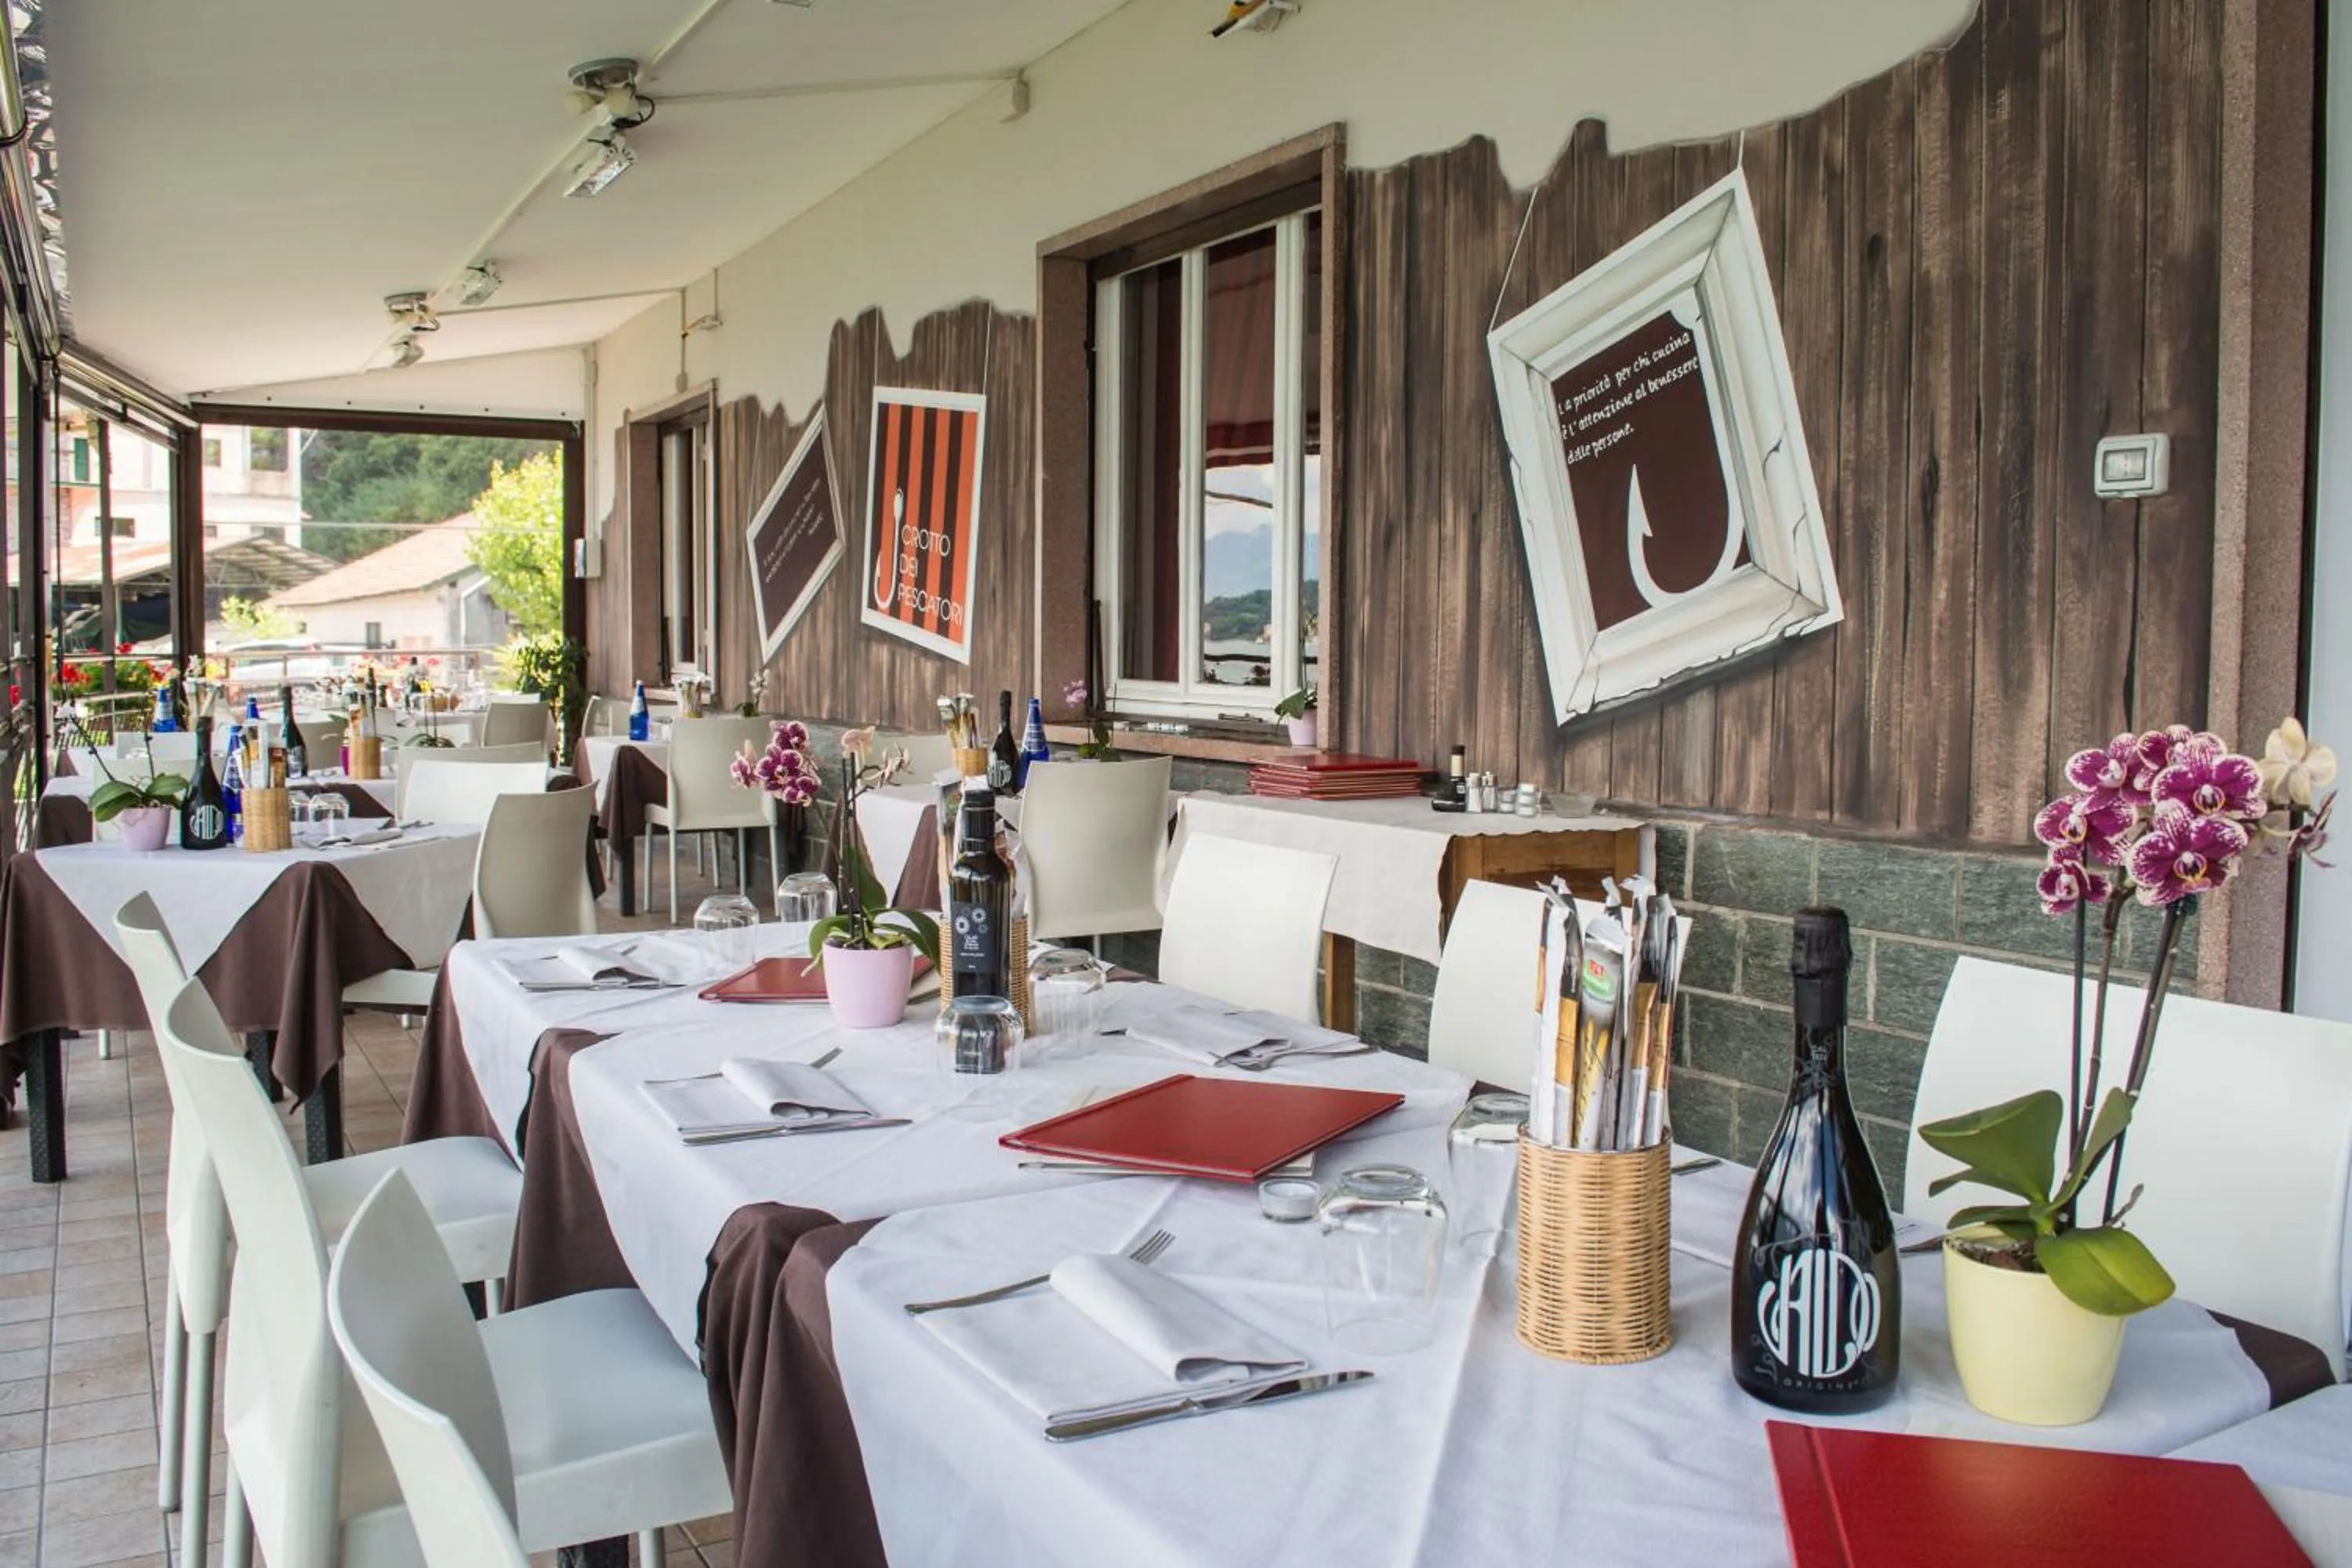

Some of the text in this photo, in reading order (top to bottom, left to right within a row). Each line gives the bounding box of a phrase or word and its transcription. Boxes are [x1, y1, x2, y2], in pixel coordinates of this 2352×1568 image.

[1559, 399, 1572, 416] La
[1615, 366, 1632, 387] per
[1633, 350, 1650, 372] chi
[1652, 332, 1690, 362] cucina
[1635, 382, 1647, 401] al
[1647, 356, 1699, 394] benessere
[1567, 423, 1634, 465] delle persone.
[902, 524, 951, 557] CROTTO
[899, 553, 918, 578] DEI
[898, 583, 964, 626] PESCATORI
